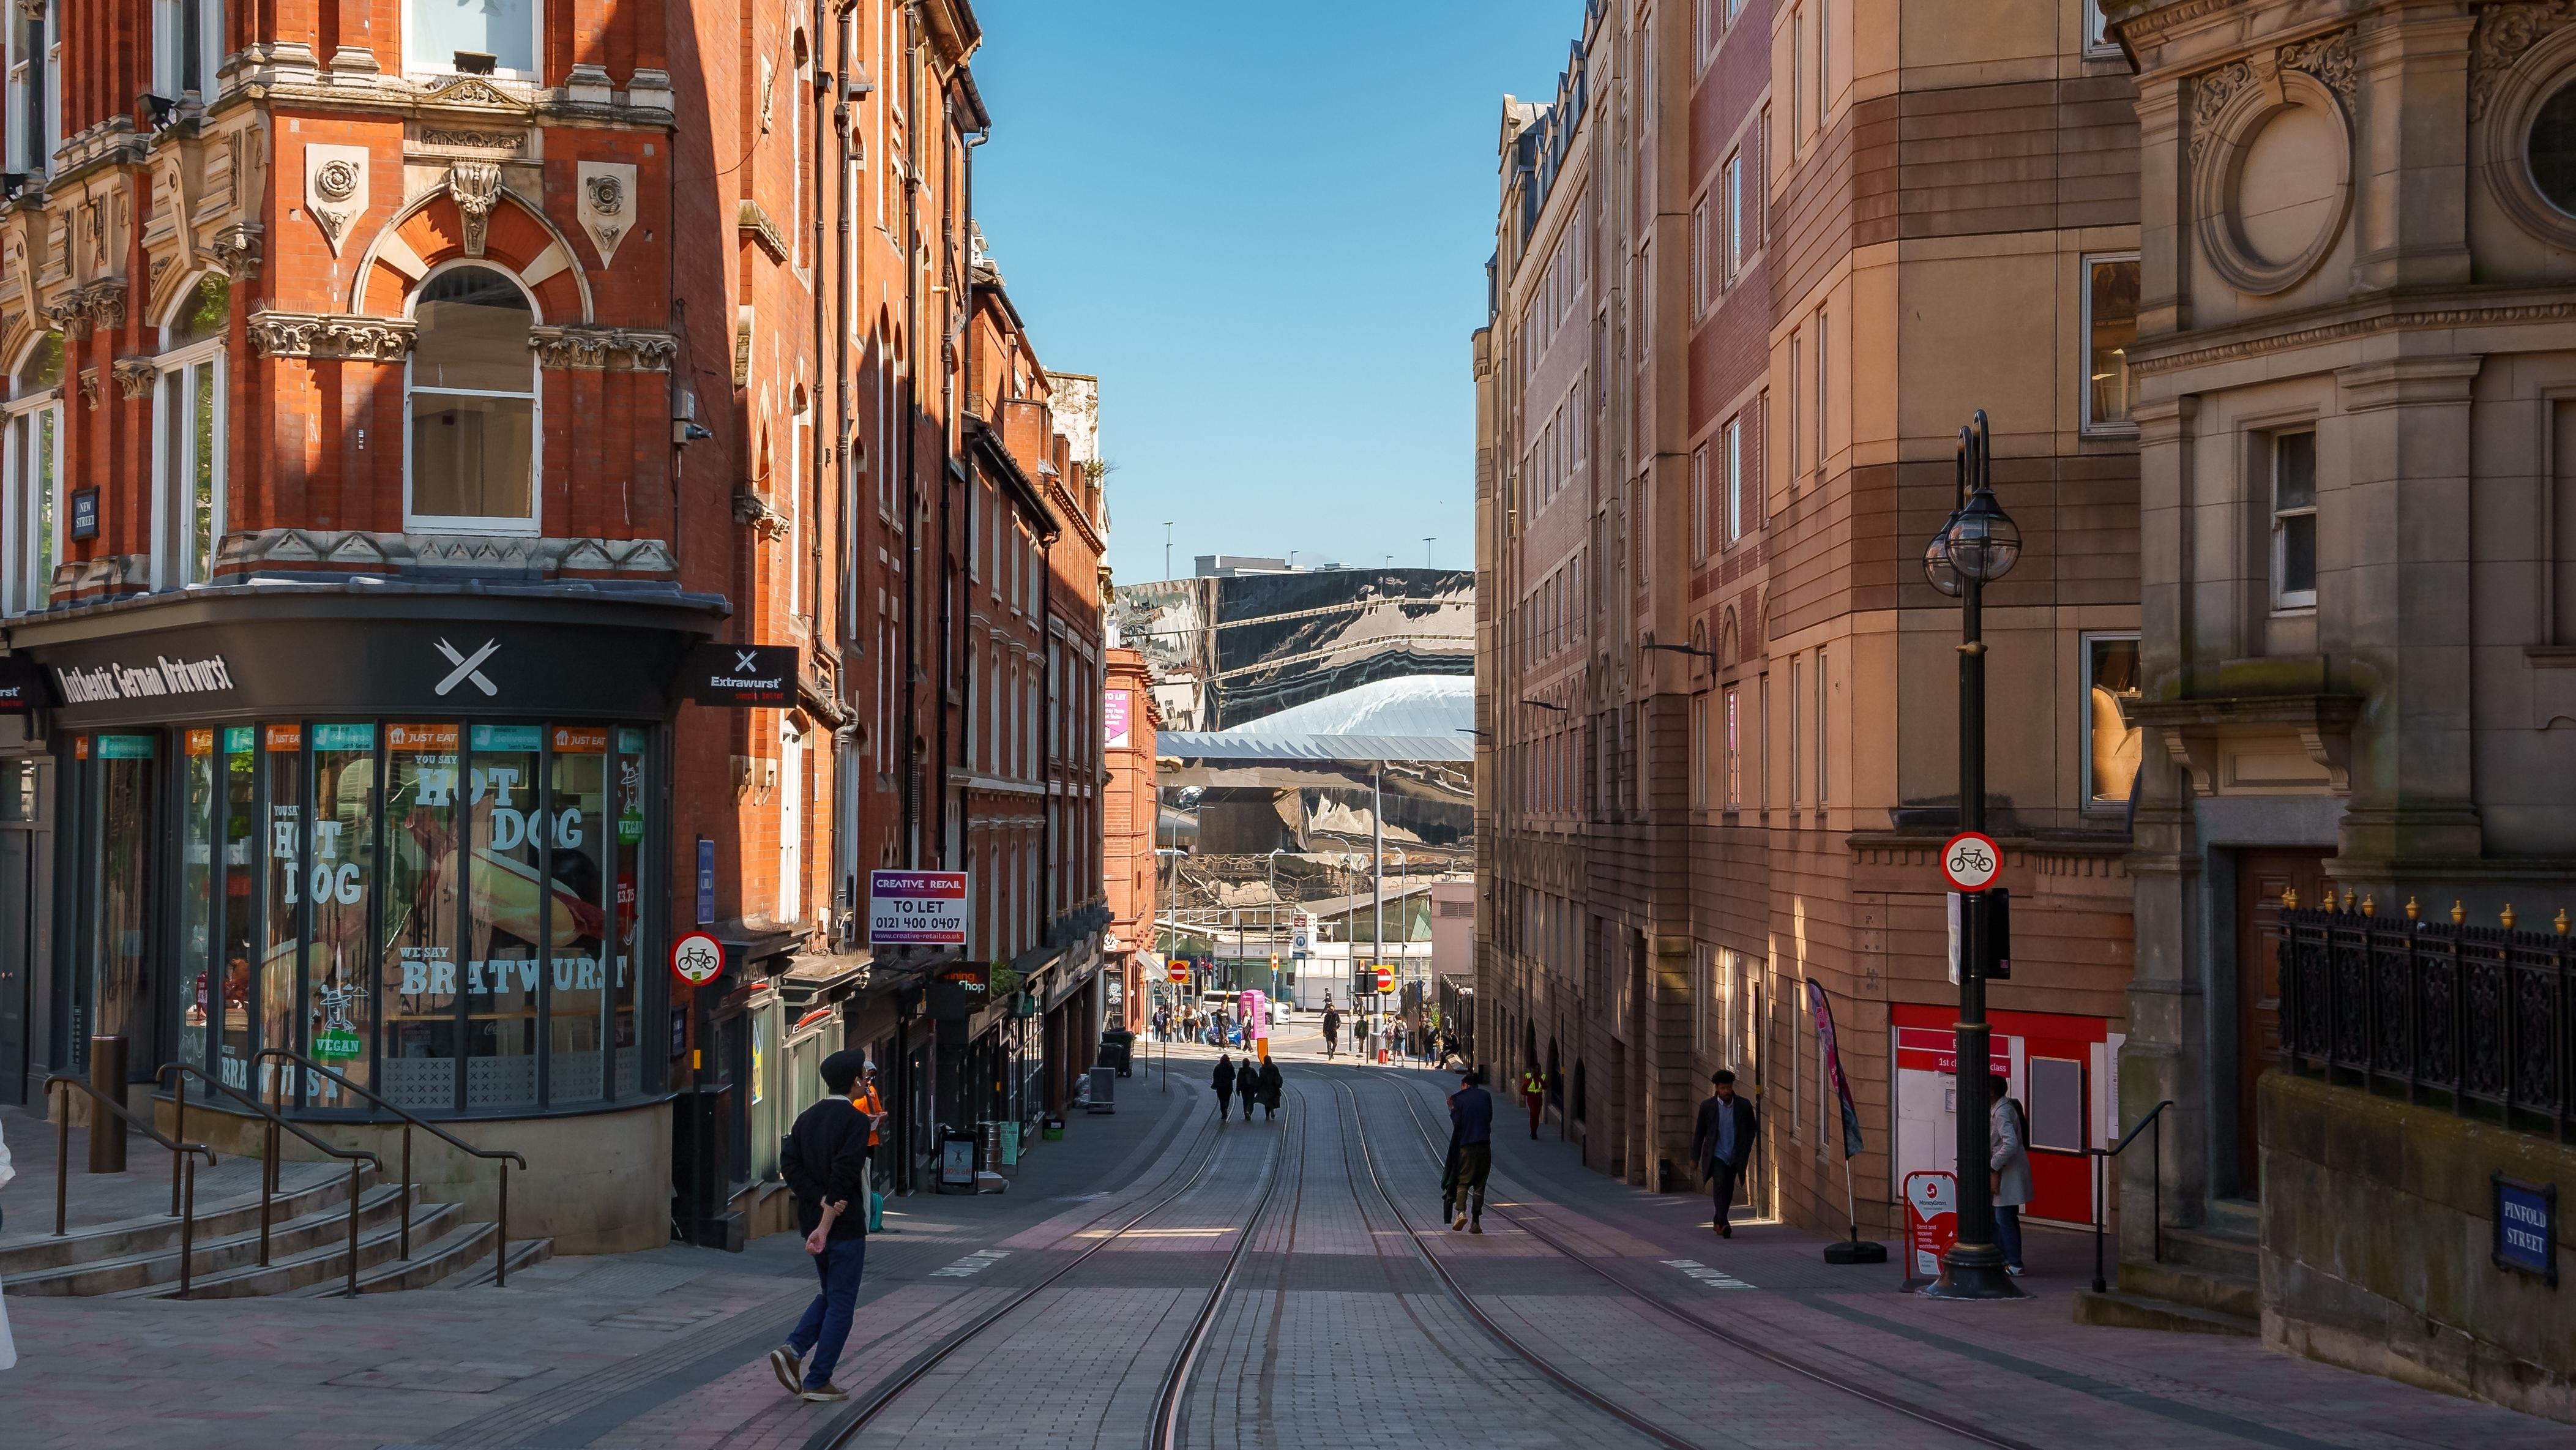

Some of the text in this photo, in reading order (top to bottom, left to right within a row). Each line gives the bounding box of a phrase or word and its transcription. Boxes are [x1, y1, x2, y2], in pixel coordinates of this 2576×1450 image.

[80, 501, 91, 513] NEW
[77, 515, 94, 528] STREET
[58, 655, 233, 703] Authentic German Bratwurst
[711, 676, 780, 689] Extrawurst
[275, 734, 288, 744] JUST
[408, 734, 458, 743] JUST EAT
[494, 734, 539, 742] deliveroo
[570, 736, 590, 746] JUST
[415, 755, 458, 764] YOU SAY
[274, 805, 286, 816] YOU
[876, 880, 961, 889] CREATIVE RETAIL
[894, 900, 944, 913] TO LET
[876, 917, 960, 929] 0121 400 0407
[400, 947, 449, 958] WE SAY
[944, 970, 975, 984] nning
[316, 1039, 360, 1053] VEGAN
[1938, 1058, 1949, 1067] 1st
[1990, 1063, 2007, 1072] class
[2504, 1201, 2546, 1228] PINFOLD
[2507, 1227, 2544, 1253] STREET
